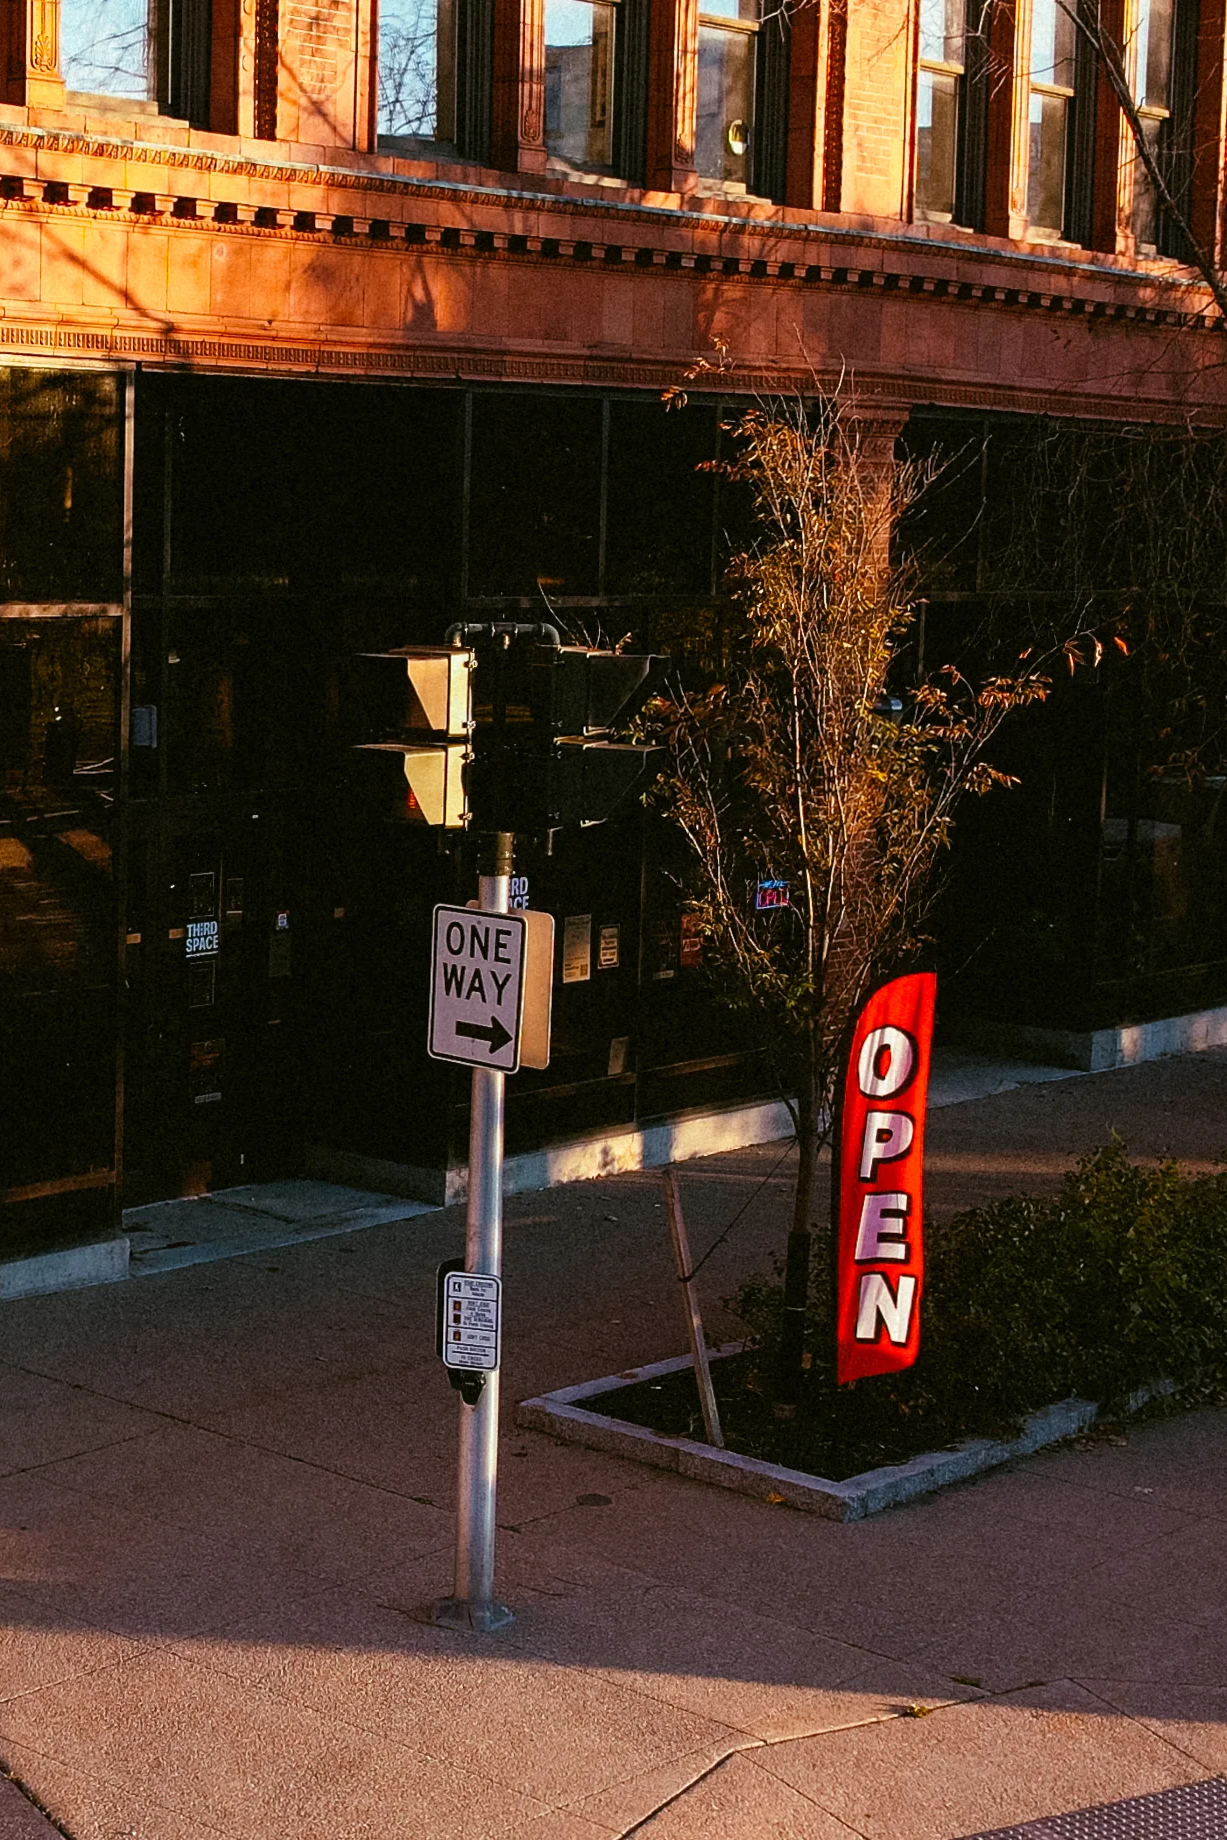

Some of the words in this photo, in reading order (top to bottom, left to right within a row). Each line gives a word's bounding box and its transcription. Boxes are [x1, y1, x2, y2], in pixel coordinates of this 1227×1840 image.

[186, 935, 219, 953] SPACE
[187, 921, 218, 938] THIRD
[446, 921, 513, 965] ONE
[443, 962, 513, 1006] WAY
[855, 1026, 918, 1344] OPEN
